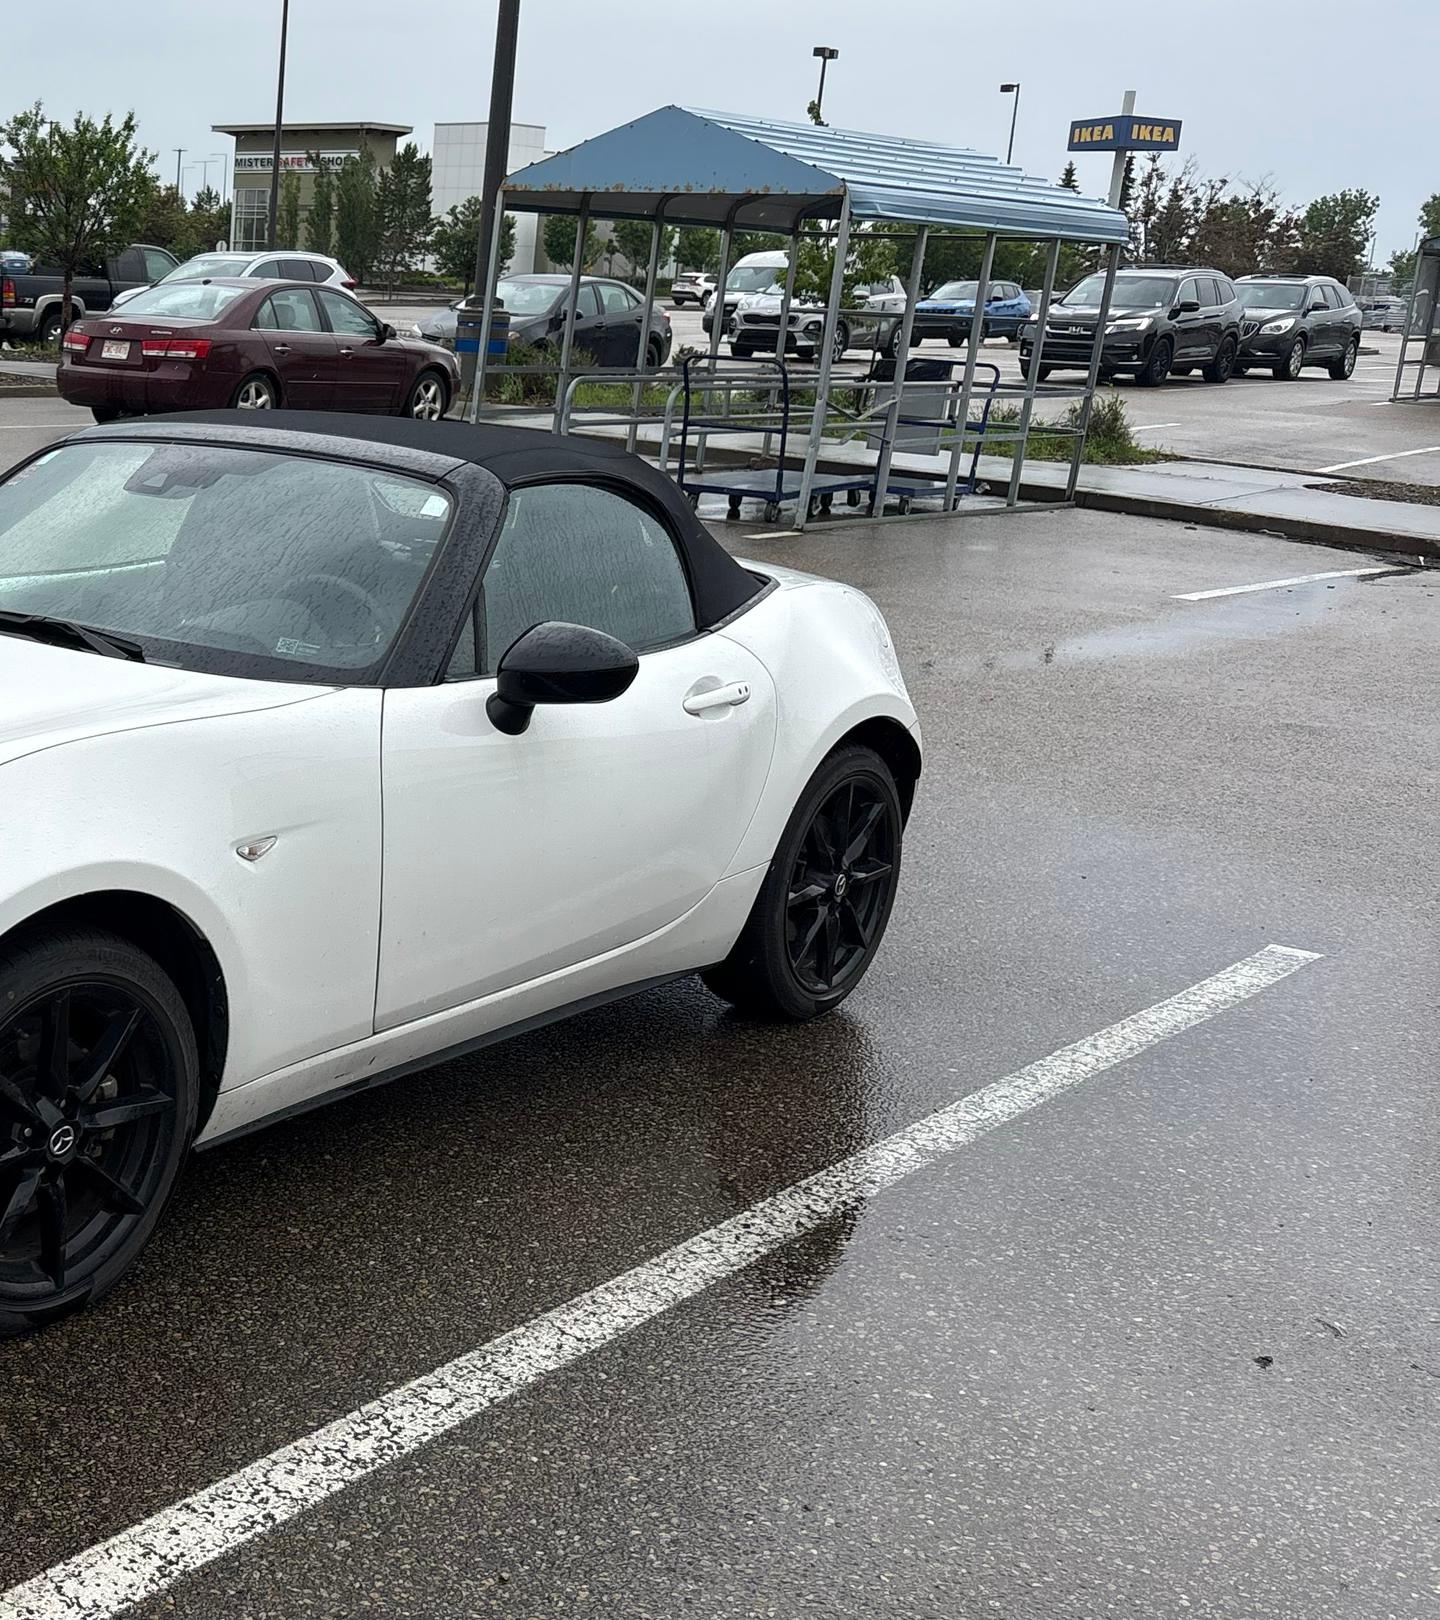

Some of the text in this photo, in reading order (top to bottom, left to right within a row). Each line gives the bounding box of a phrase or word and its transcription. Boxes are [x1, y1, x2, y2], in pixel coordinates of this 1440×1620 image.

[1073, 124, 1114, 143] IKEA
[1131, 124, 1175, 143] IKEA
[235, 157, 274, 168] MISTER
